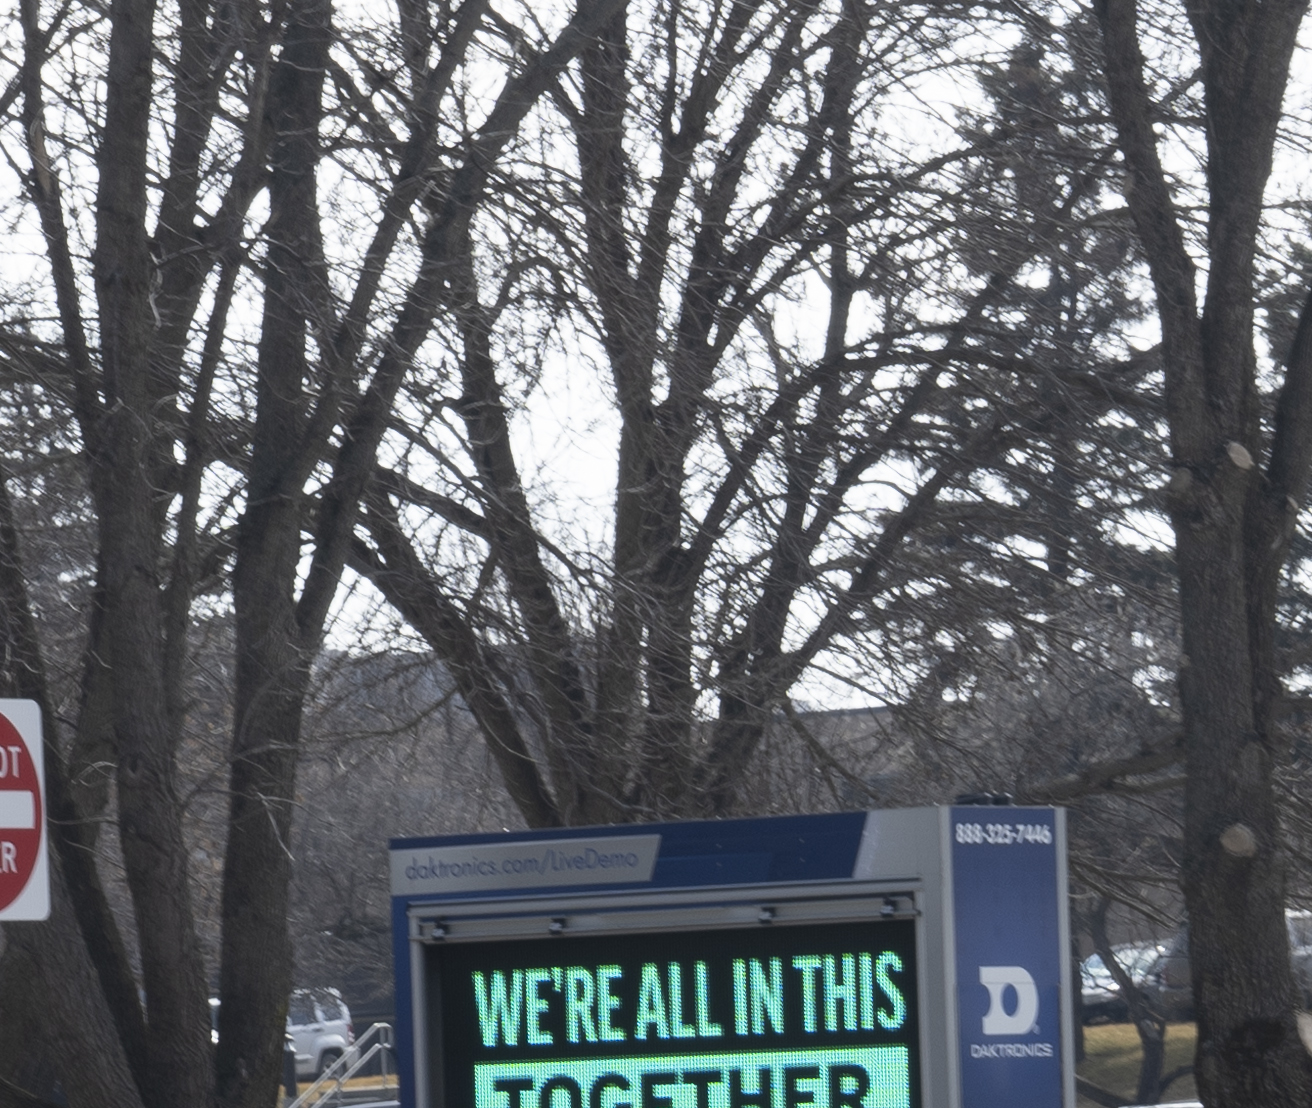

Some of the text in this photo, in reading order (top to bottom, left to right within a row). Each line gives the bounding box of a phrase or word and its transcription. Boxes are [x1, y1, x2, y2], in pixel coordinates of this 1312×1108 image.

[955, 822, 1053, 844] 888-325-7446
[405, 847, 637, 880] daktronics.com/LiveDemo
[472, 950, 907, 1047] WE'RE ALL IN THIS
[970, 1043, 1053, 1058] DAKTRONICS
